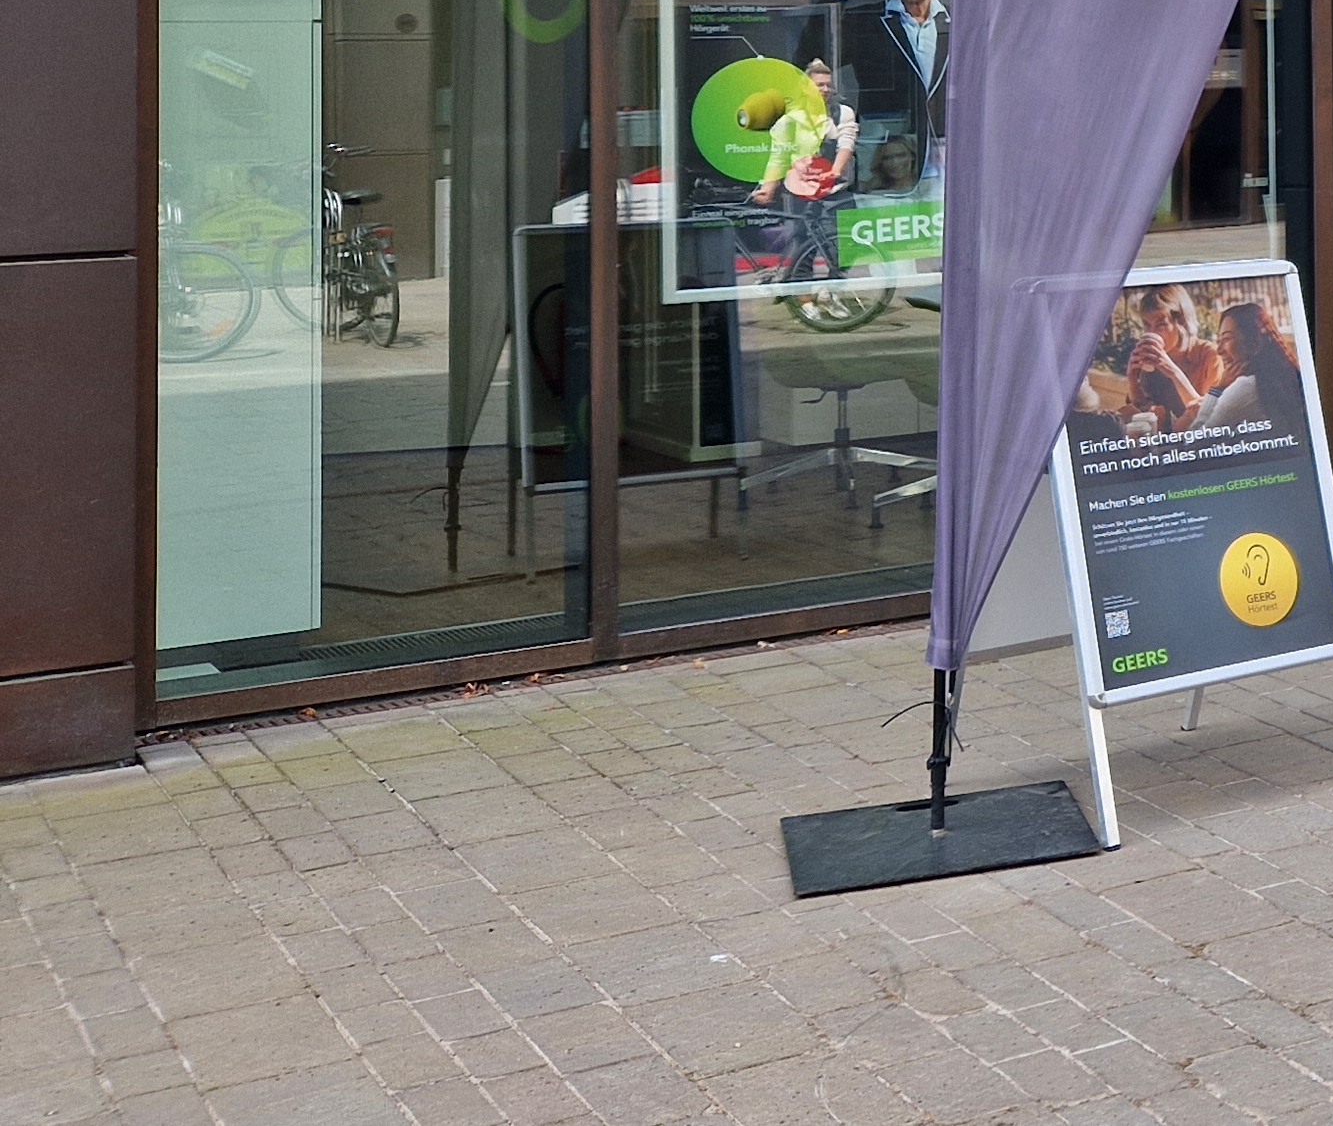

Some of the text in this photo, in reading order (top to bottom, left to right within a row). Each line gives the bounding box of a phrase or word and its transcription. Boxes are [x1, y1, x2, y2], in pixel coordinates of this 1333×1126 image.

[725, 144, 768, 154] Phonak
[851, 212, 944, 246] GEERS
[1079, 418, 1272, 455] Einfach sichergehen, dass
[1083, 434, 1299, 475] man noch alles mitbekommt.
[1089, 497, 1128, 512] Machen
[1129, 495, 1145, 507] Sie
[1147, 491, 1167, 504] den
[1168, 483, 1226, 500] kostenlosen
[1226, 478, 1259, 492] GEERS
[1246, 590, 1277, 604] GEERS
[1248, 603, 1278, 614] Hörtest
[1112, 648, 1169, 673] GEERS
